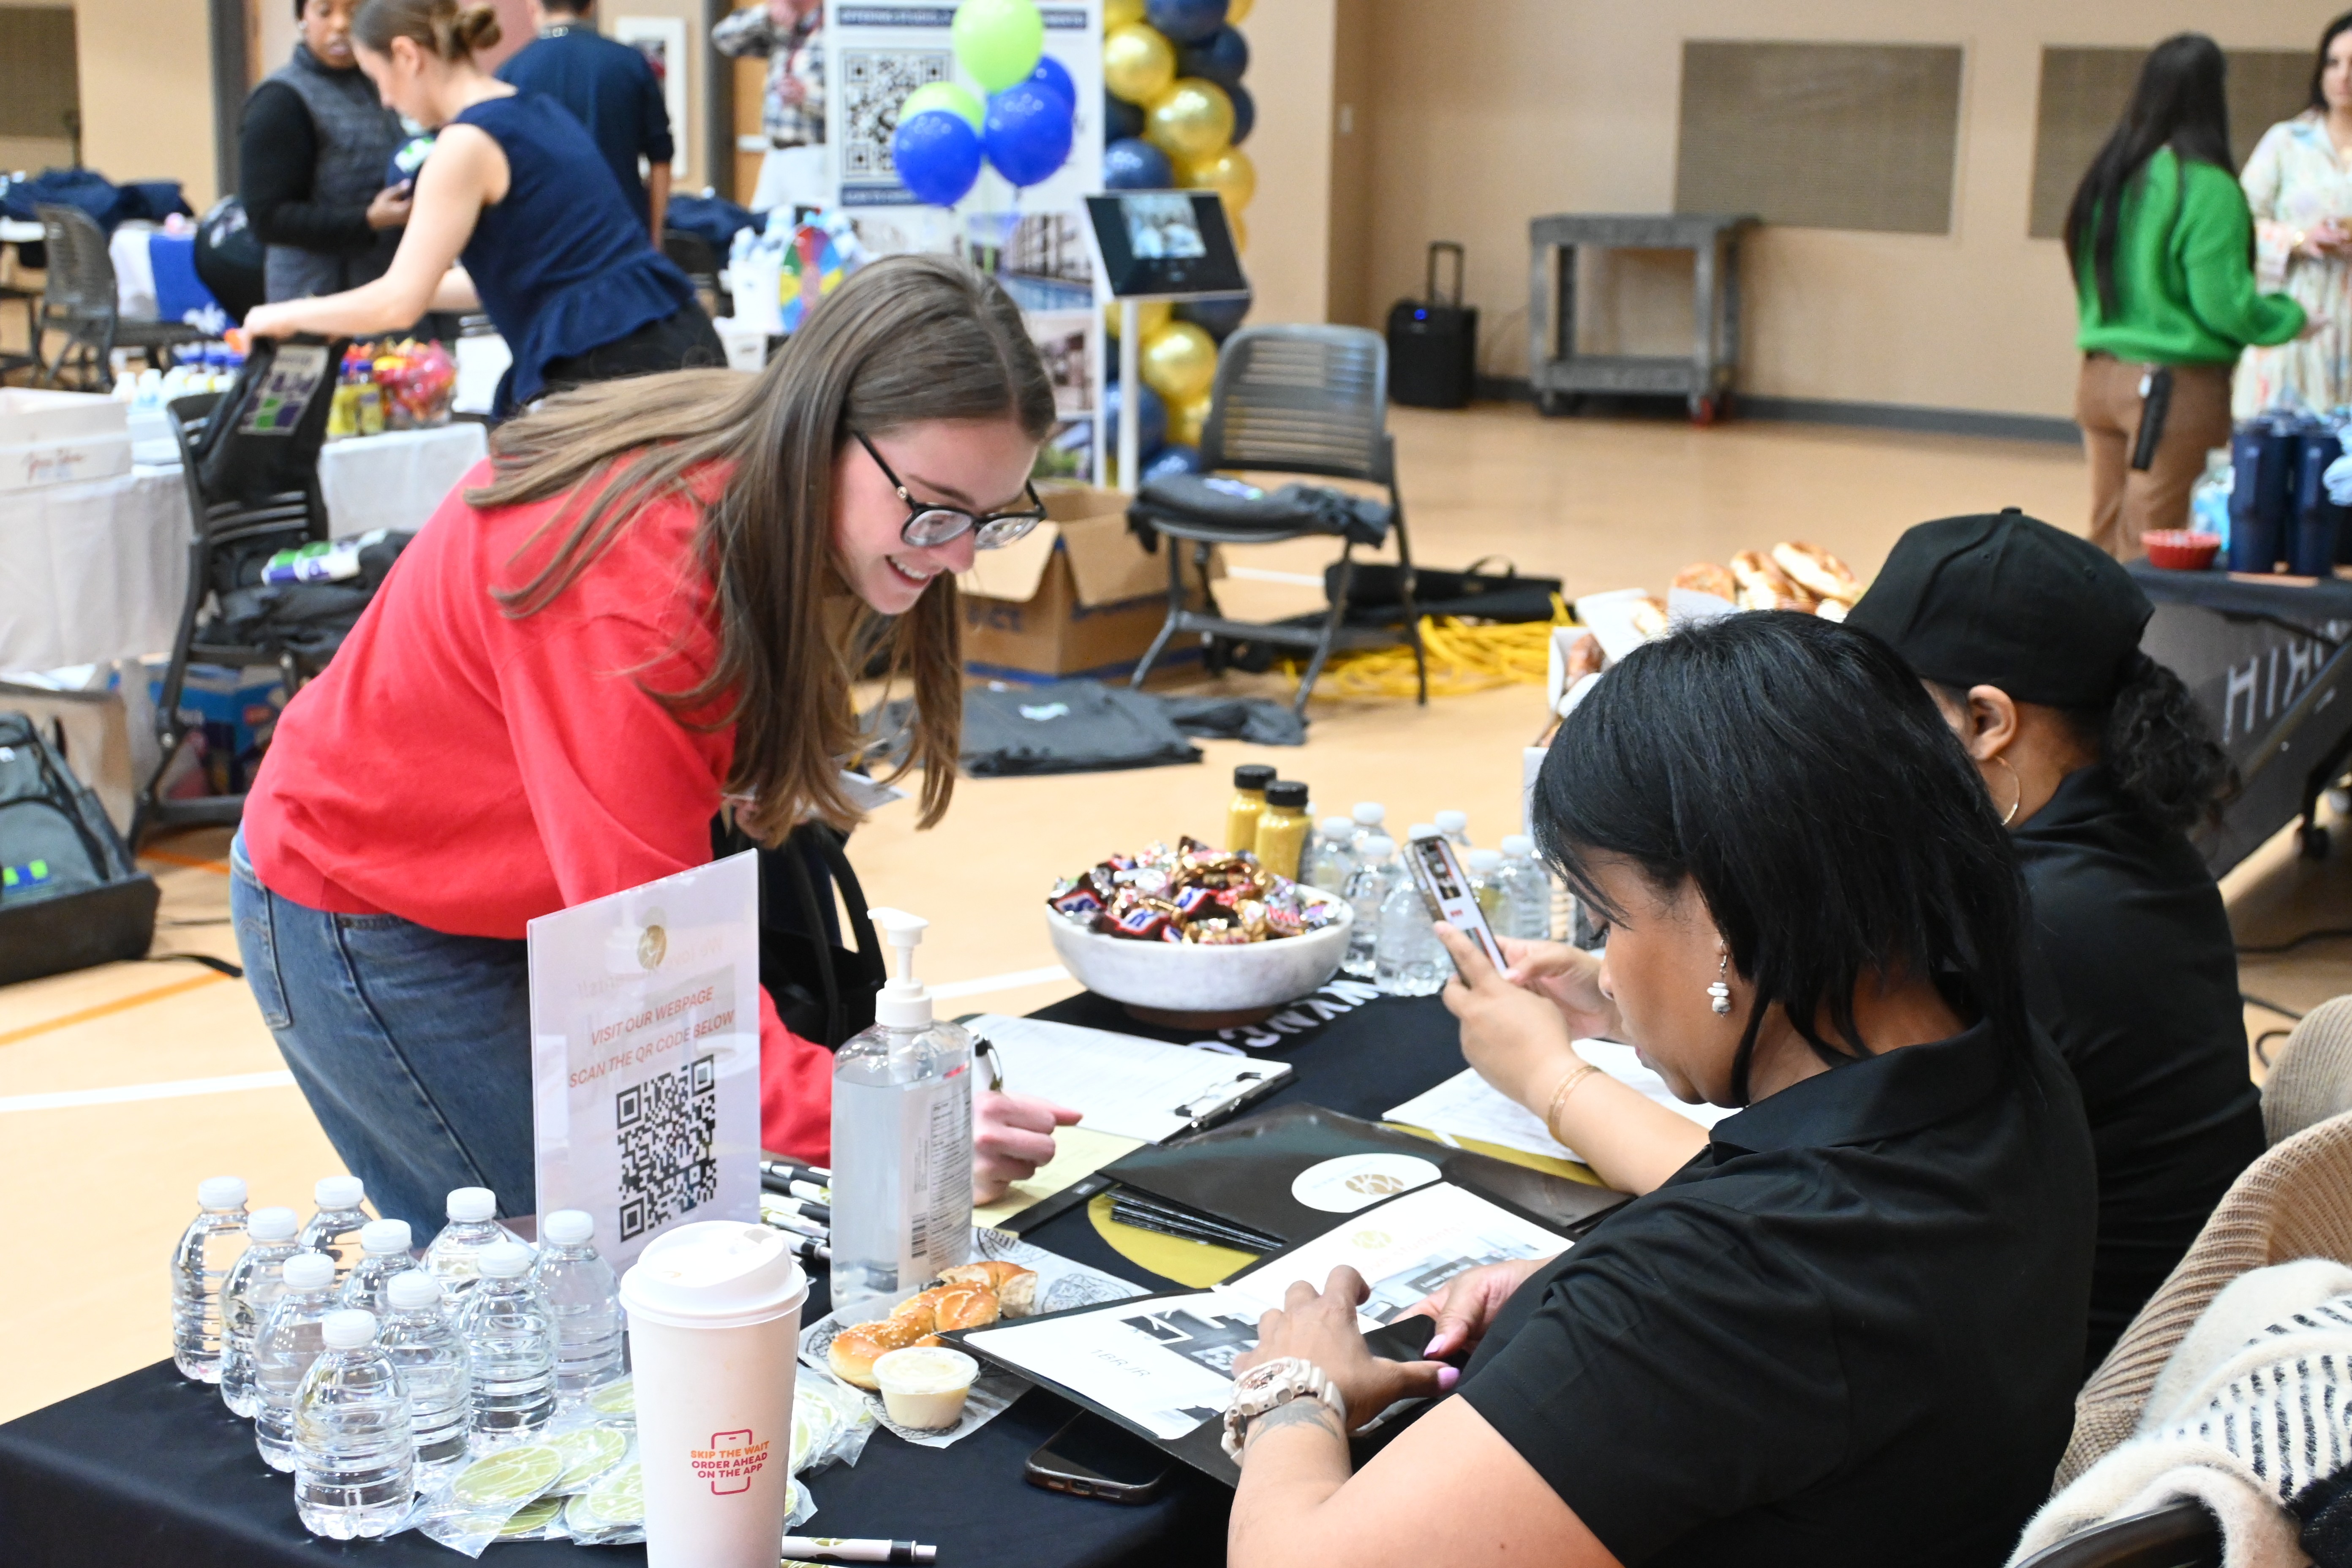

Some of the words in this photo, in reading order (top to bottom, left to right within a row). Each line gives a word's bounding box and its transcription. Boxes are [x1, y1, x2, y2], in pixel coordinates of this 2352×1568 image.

[592, 1021, 623, 1046] VISIT
[626, 1011, 653, 1032] OUR
[655, 986, 714, 1021] WEBPAGE
[569, 1064, 605, 1088] SCAN
[610, 1050, 632, 1072] THE
[636, 1042, 653, 1063] QR
[656, 1027, 690, 1053] CODE
[693, 1009, 735, 1038] BELOW
[1091, 1349, 1128, 1366] 1BR
[1123, 1367, 1150, 1377] JR
[691, 1450, 716, 1459] SKIP
[719, 1448, 741, 1458] THE
[744, 1440, 770, 1455] WAIT
[691, 1460, 730, 1469] ORDER
[733, 1452, 768, 1467] AHEAD
[719, 1468, 740, 1478] THE
[743, 1463, 763, 1475] APP
